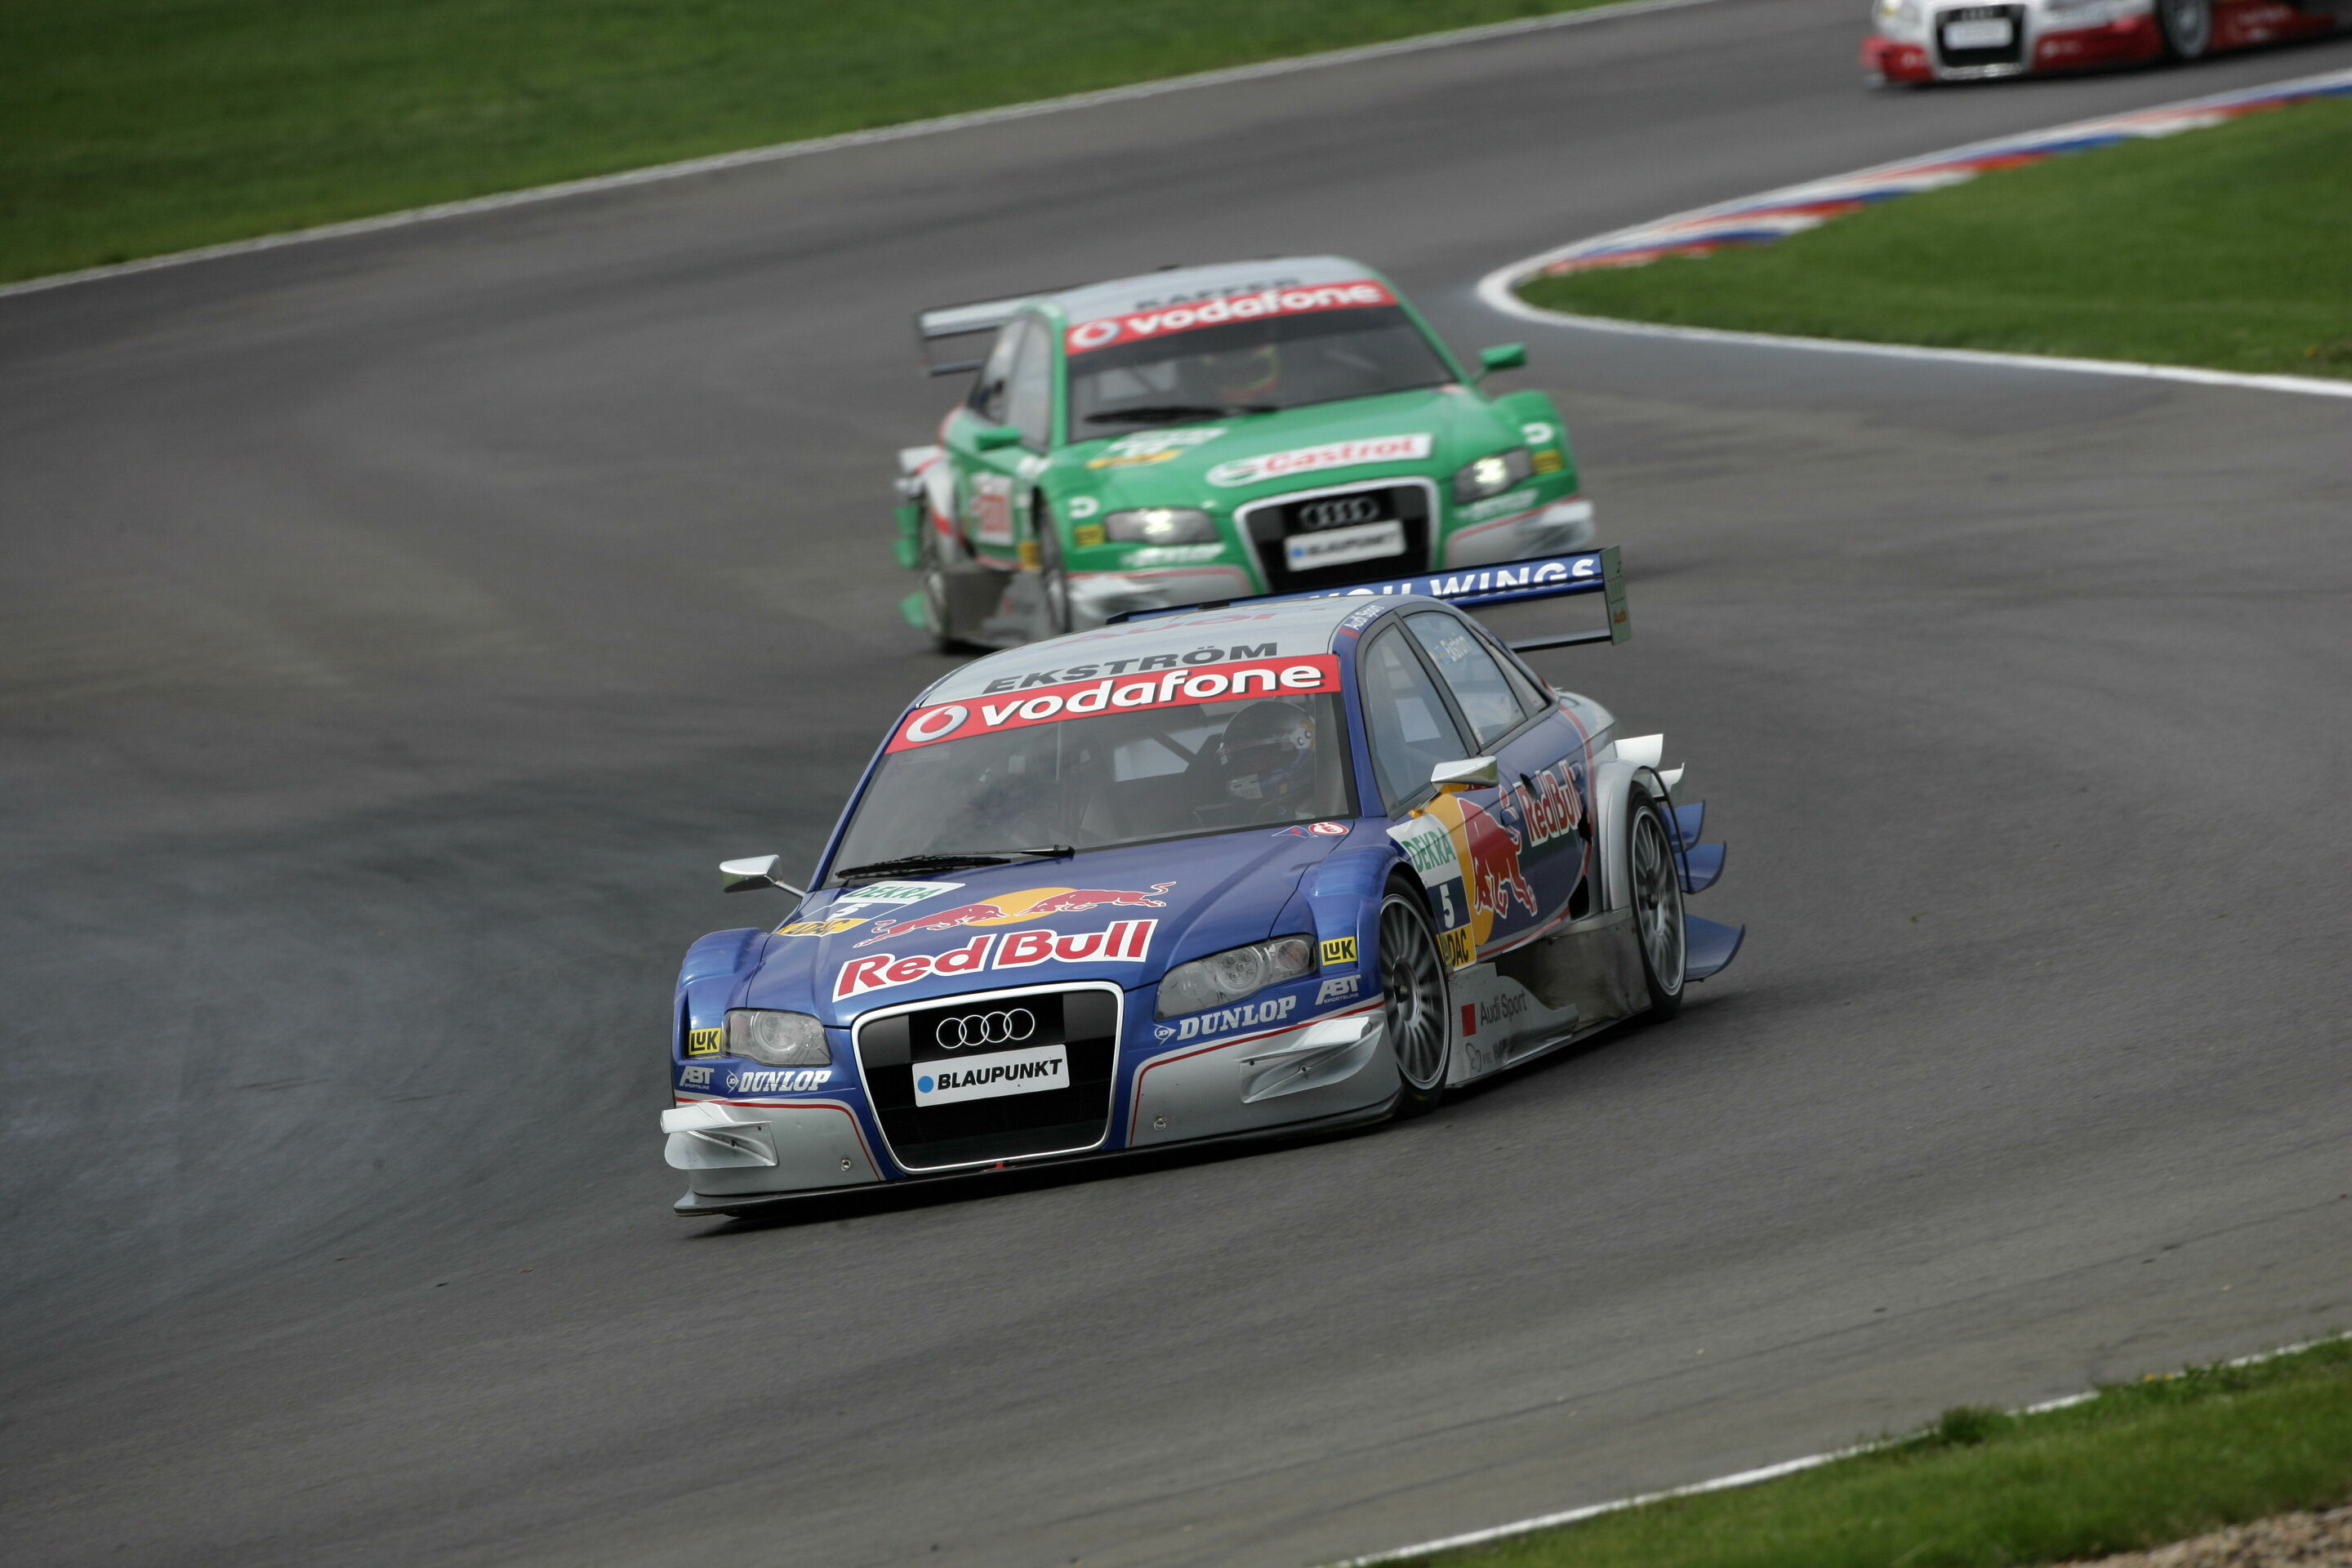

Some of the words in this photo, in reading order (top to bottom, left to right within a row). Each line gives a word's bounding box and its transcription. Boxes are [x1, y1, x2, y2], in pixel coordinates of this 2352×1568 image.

[1129, 283, 1383, 334] vodafone
[1265, 437, 1414, 473] Castrol
[1429, 558, 1595, 597] WINGS
[982, 642, 1278, 694] EKSTRÖM
[980, 665, 1325, 727] vodafone
[1511, 768, 1561, 847] Red
[1401, 826, 1457, 873] DEKRA
[824, 903, 873, 921] 5
[844, 886, 945, 899] DEKRA
[1440, 884, 1454, 929] 5
[835, 935, 994, 1000] Red
[993, 920, 1156, 969] Bull
[1315, 973, 1361, 1005] ABT
[1480, 996, 1501, 1026] Audi
[1501, 989, 1527, 1022] Sport
[1177, 995, 1297, 1040] DUNLOP
[679, 1065, 715, 1087] ABT
[738, 1071, 832, 1092] DUNLOP
[938, 1058, 1062, 1090] BLAUPUNKT
